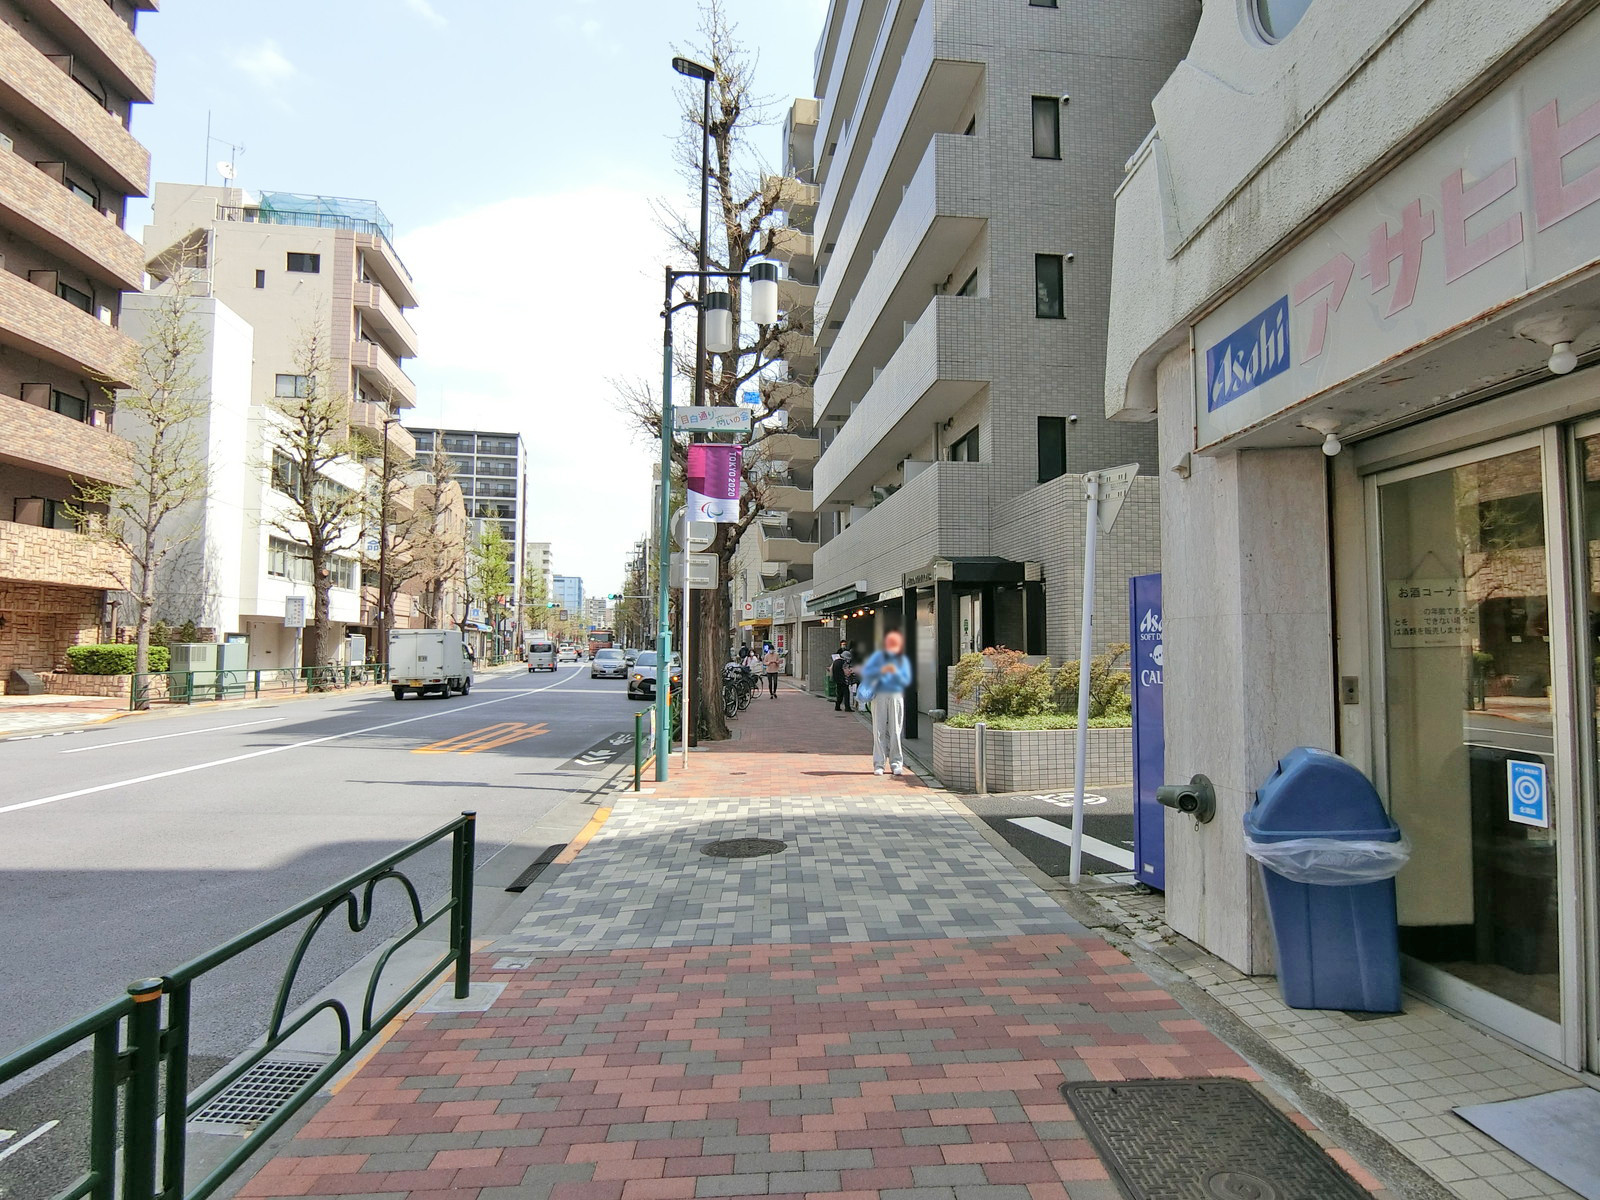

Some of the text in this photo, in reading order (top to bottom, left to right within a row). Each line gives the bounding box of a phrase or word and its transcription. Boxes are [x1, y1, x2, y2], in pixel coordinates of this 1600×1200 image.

[1212, 306, 1286, 402] Asahi
[727, 451, 737, 497] TOKYO 2020
[1398, 586, 1467, 599] お酒コーナー
[1140, 633, 1155, 641] SOFT
